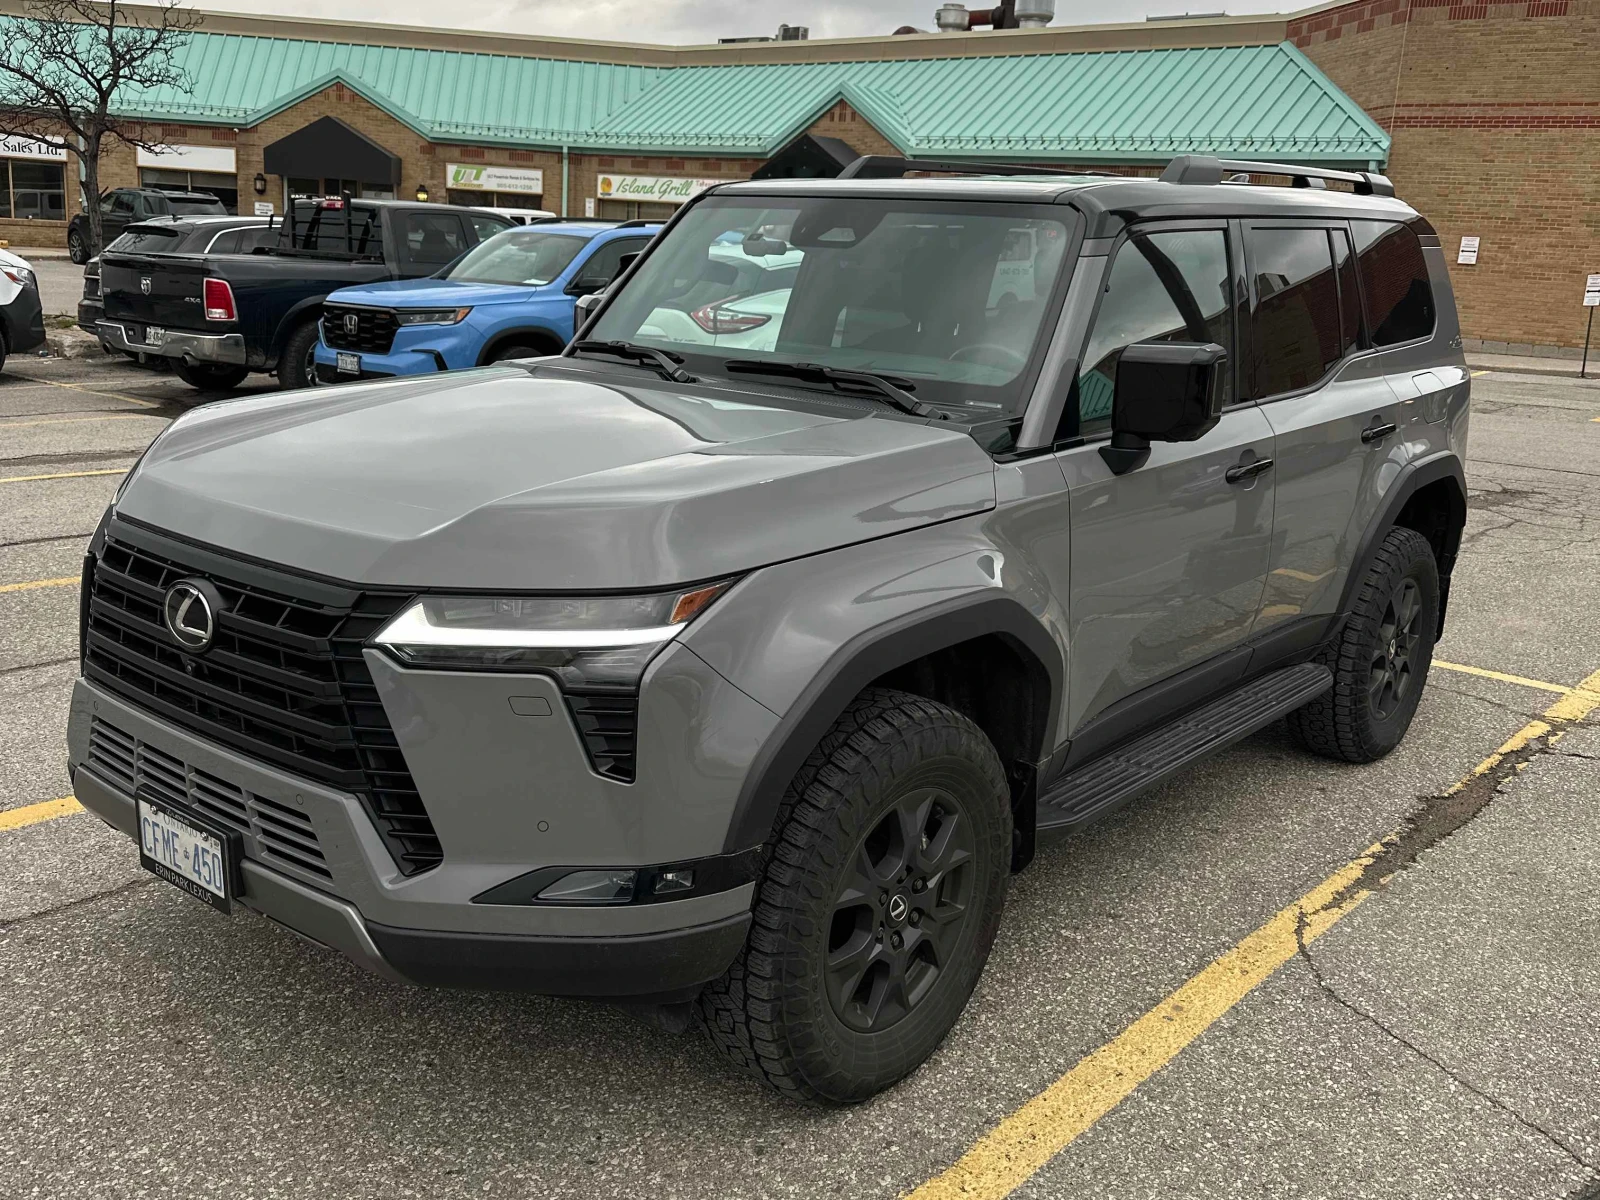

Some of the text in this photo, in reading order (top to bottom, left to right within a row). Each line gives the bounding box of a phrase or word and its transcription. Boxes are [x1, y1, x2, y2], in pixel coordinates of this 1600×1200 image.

[2, 141, 62, 156] Sales Ltd.
[616, 178, 658, 195] Island
[658, 180, 694, 199] Grill
[142, 817, 223, 892] CFME 450
[155, 863, 213, 904] ERIN PARK LEXUS
